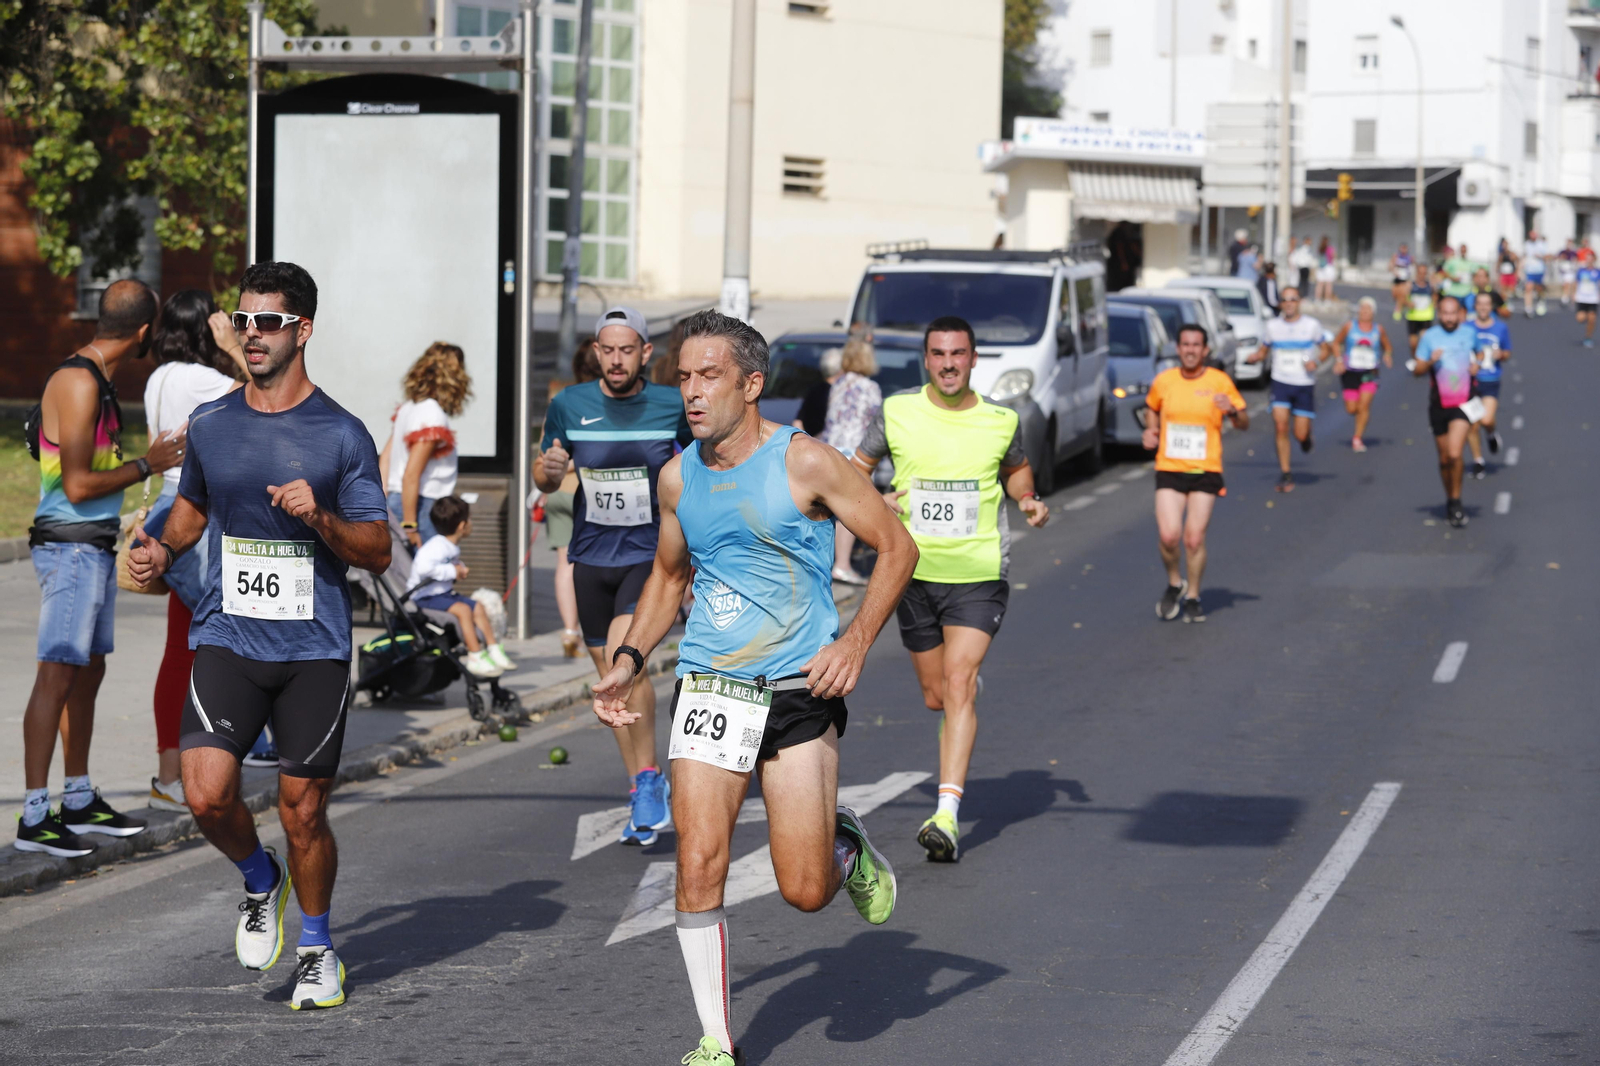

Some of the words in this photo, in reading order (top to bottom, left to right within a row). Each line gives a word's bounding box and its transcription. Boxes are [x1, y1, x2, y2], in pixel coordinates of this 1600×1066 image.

[360, 102, 383, 114] Clear
[384, 102, 420, 114] Channel
[1058, 136, 1134, 150] PATATAS
[1137, 140, 1194, 153] FRITAS
[923, 482, 945, 491] VUELTA
[952, 481, 976, 491] HUELVA
[595, 491, 625, 511] 675
[921, 502, 954, 522] 628
[228, 541, 236, 552] 34
[238, 543, 268, 556] VUELTA
[269, 546, 276, 556] A
[277, 545, 308, 557] HUELVA
[239, 556, 272, 565] GONZALO
[237, 570, 280, 598] 546
[686, 680, 696, 690] 34
[697, 680, 722, 692] VUELTA
[723, 683, 730, 695] A
[732, 684, 764, 703] HUELVA
[683, 708, 728, 741] 629
